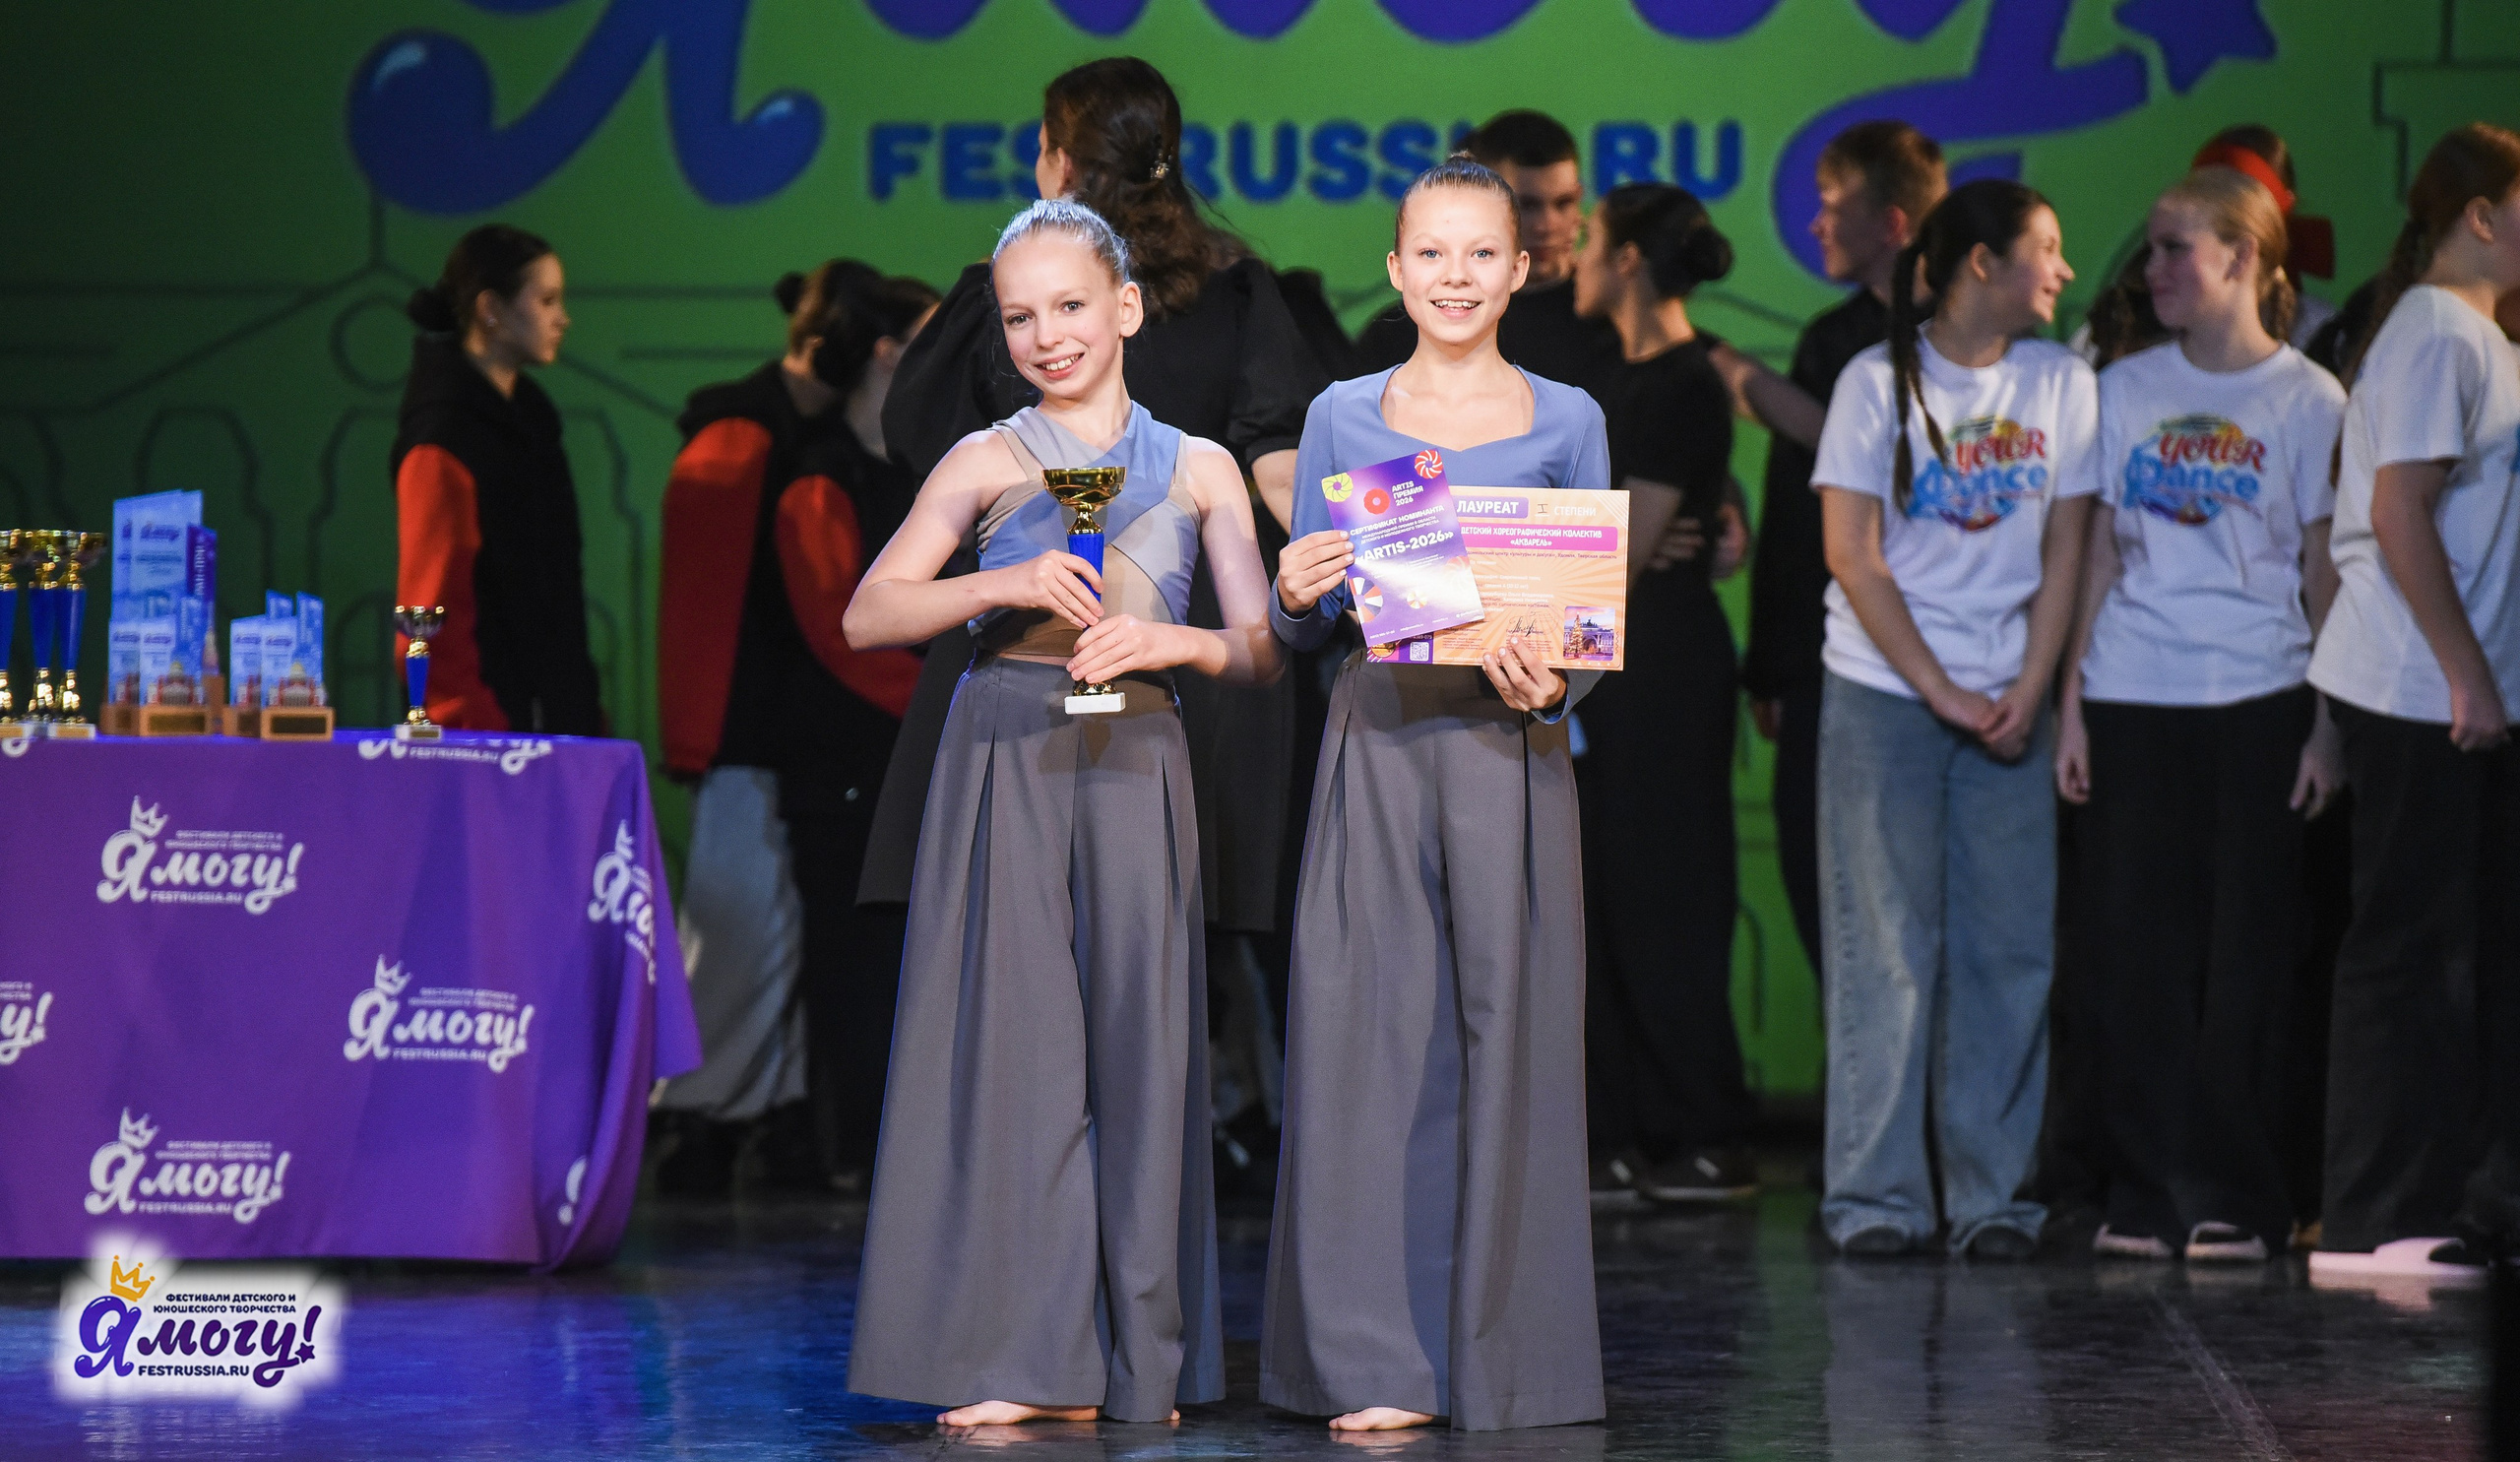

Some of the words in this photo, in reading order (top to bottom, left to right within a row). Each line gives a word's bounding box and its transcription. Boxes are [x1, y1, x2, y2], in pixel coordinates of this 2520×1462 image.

[1392, 480, 1415, 492] ARTIS
[1393, 485, 1424, 499] ПРЕМИЯ
[1395, 496, 1415, 506] 2026
[1457, 500, 1519, 514] ЛАУРЕАТ
[1553, 505, 1597, 516] СТЕПЕНИ
[1350, 517, 1398, 536] СЕРТИФИКАТ
[1398, 505, 1445, 524] НОМИНАНТА
[1461, 526, 1492, 535] ДЕТСКИЙ
[1492, 527, 1562, 538] ХОРЕОГРАФИЧЕСКИЙ
[1562, 530, 1603, 539] КОЛЛЕКТИВ
[96, 830, 158, 903] Я
[150, 842, 305, 916] могу!
[344, 987, 400, 1061] Я
[392, 1003, 536, 1073] могу!
[84, 1141, 147, 1215] Я
[138, 1151, 292, 1225] могу!
